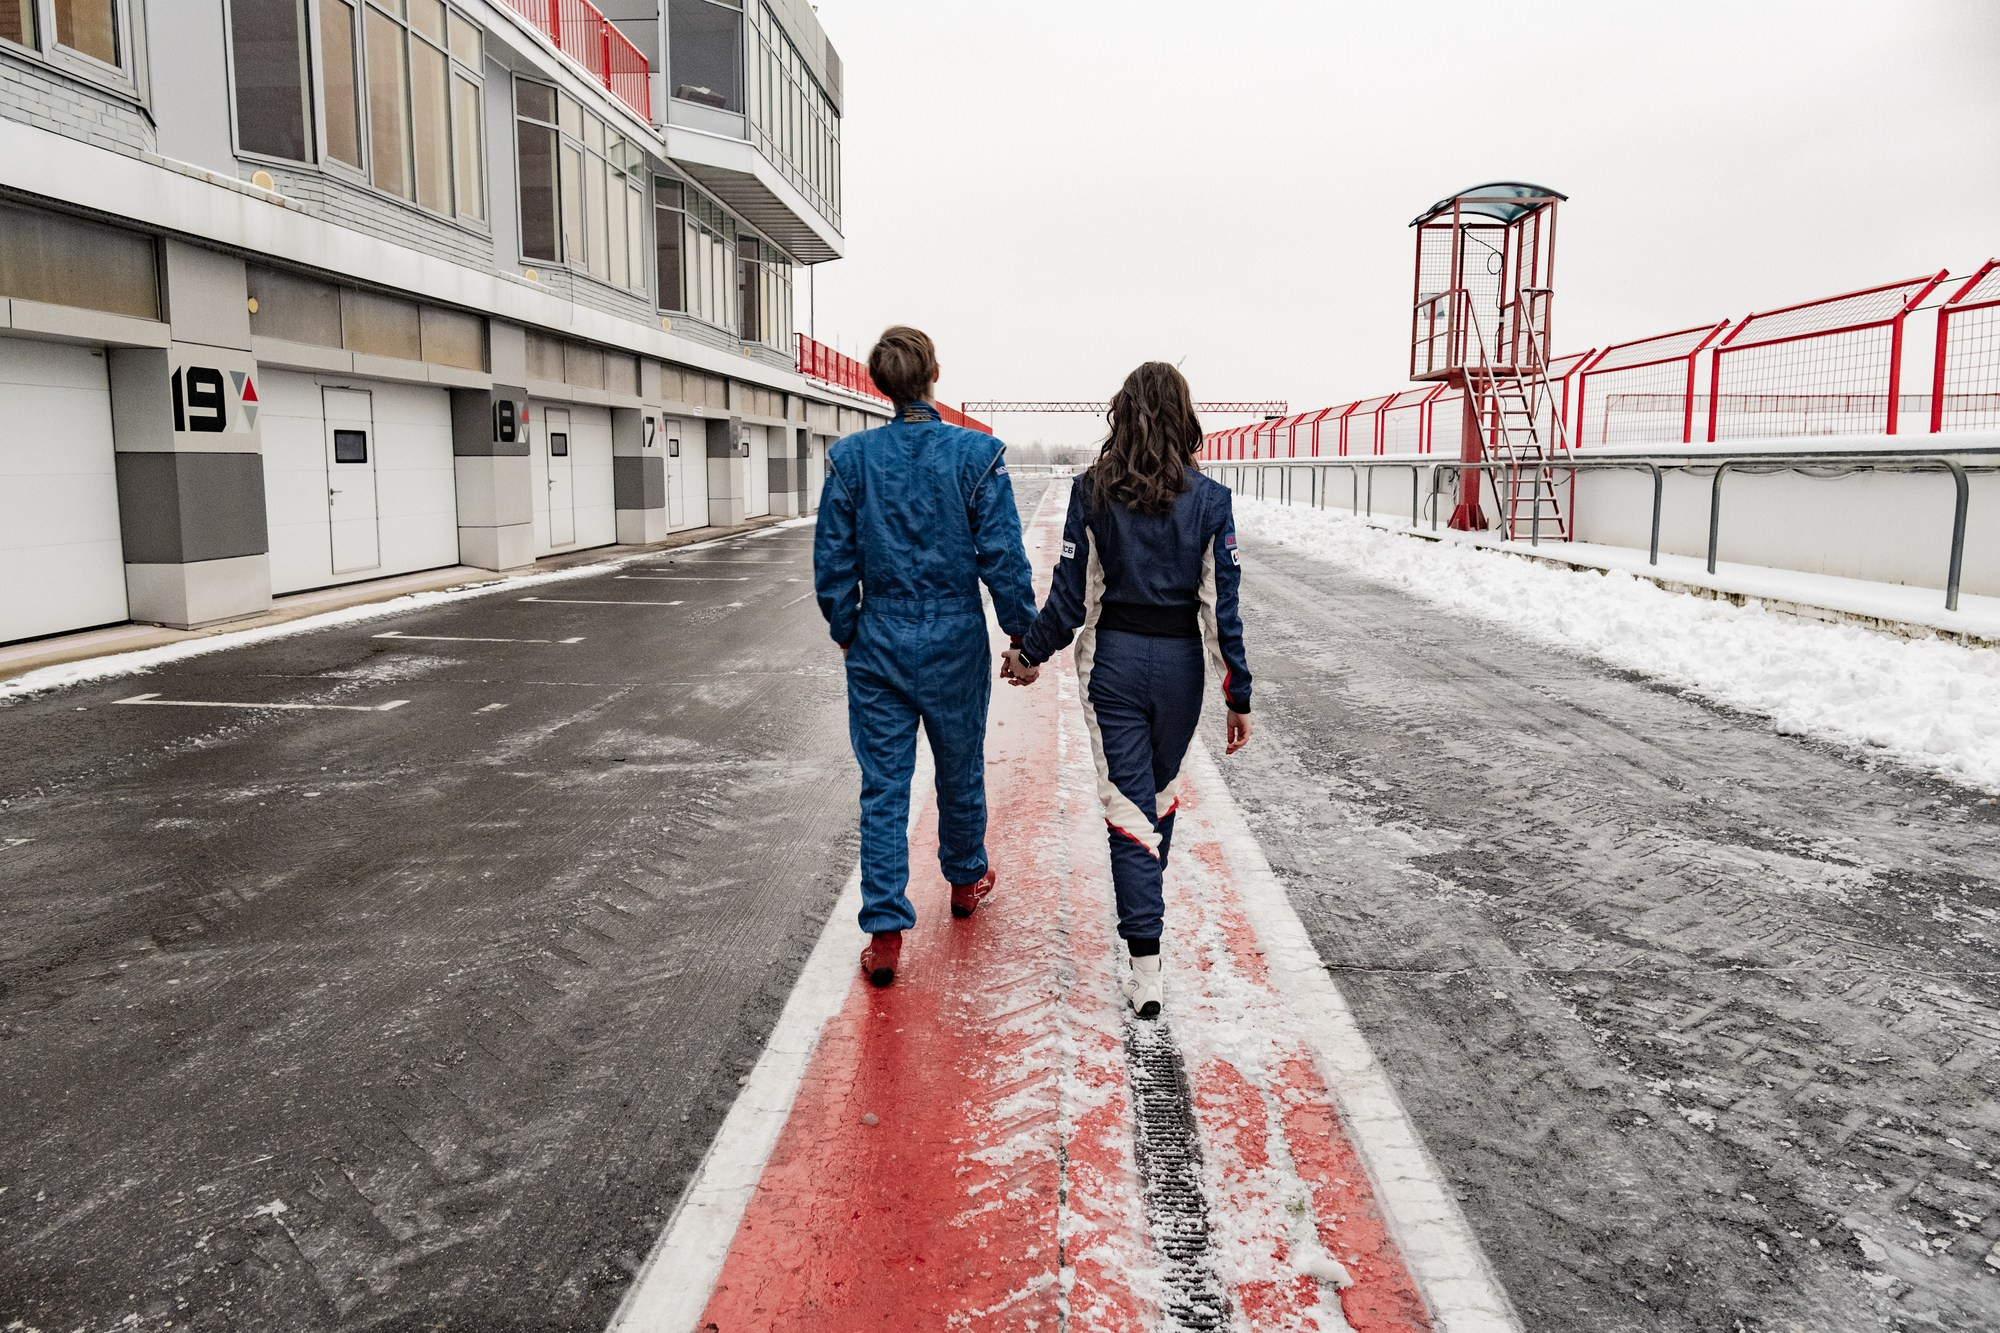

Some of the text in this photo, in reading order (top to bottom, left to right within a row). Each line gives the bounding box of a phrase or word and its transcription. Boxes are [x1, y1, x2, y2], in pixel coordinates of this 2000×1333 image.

[171, 365, 227, 432] 19
[492, 400, 515, 442] 18
[642, 416, 655, 447] 17
